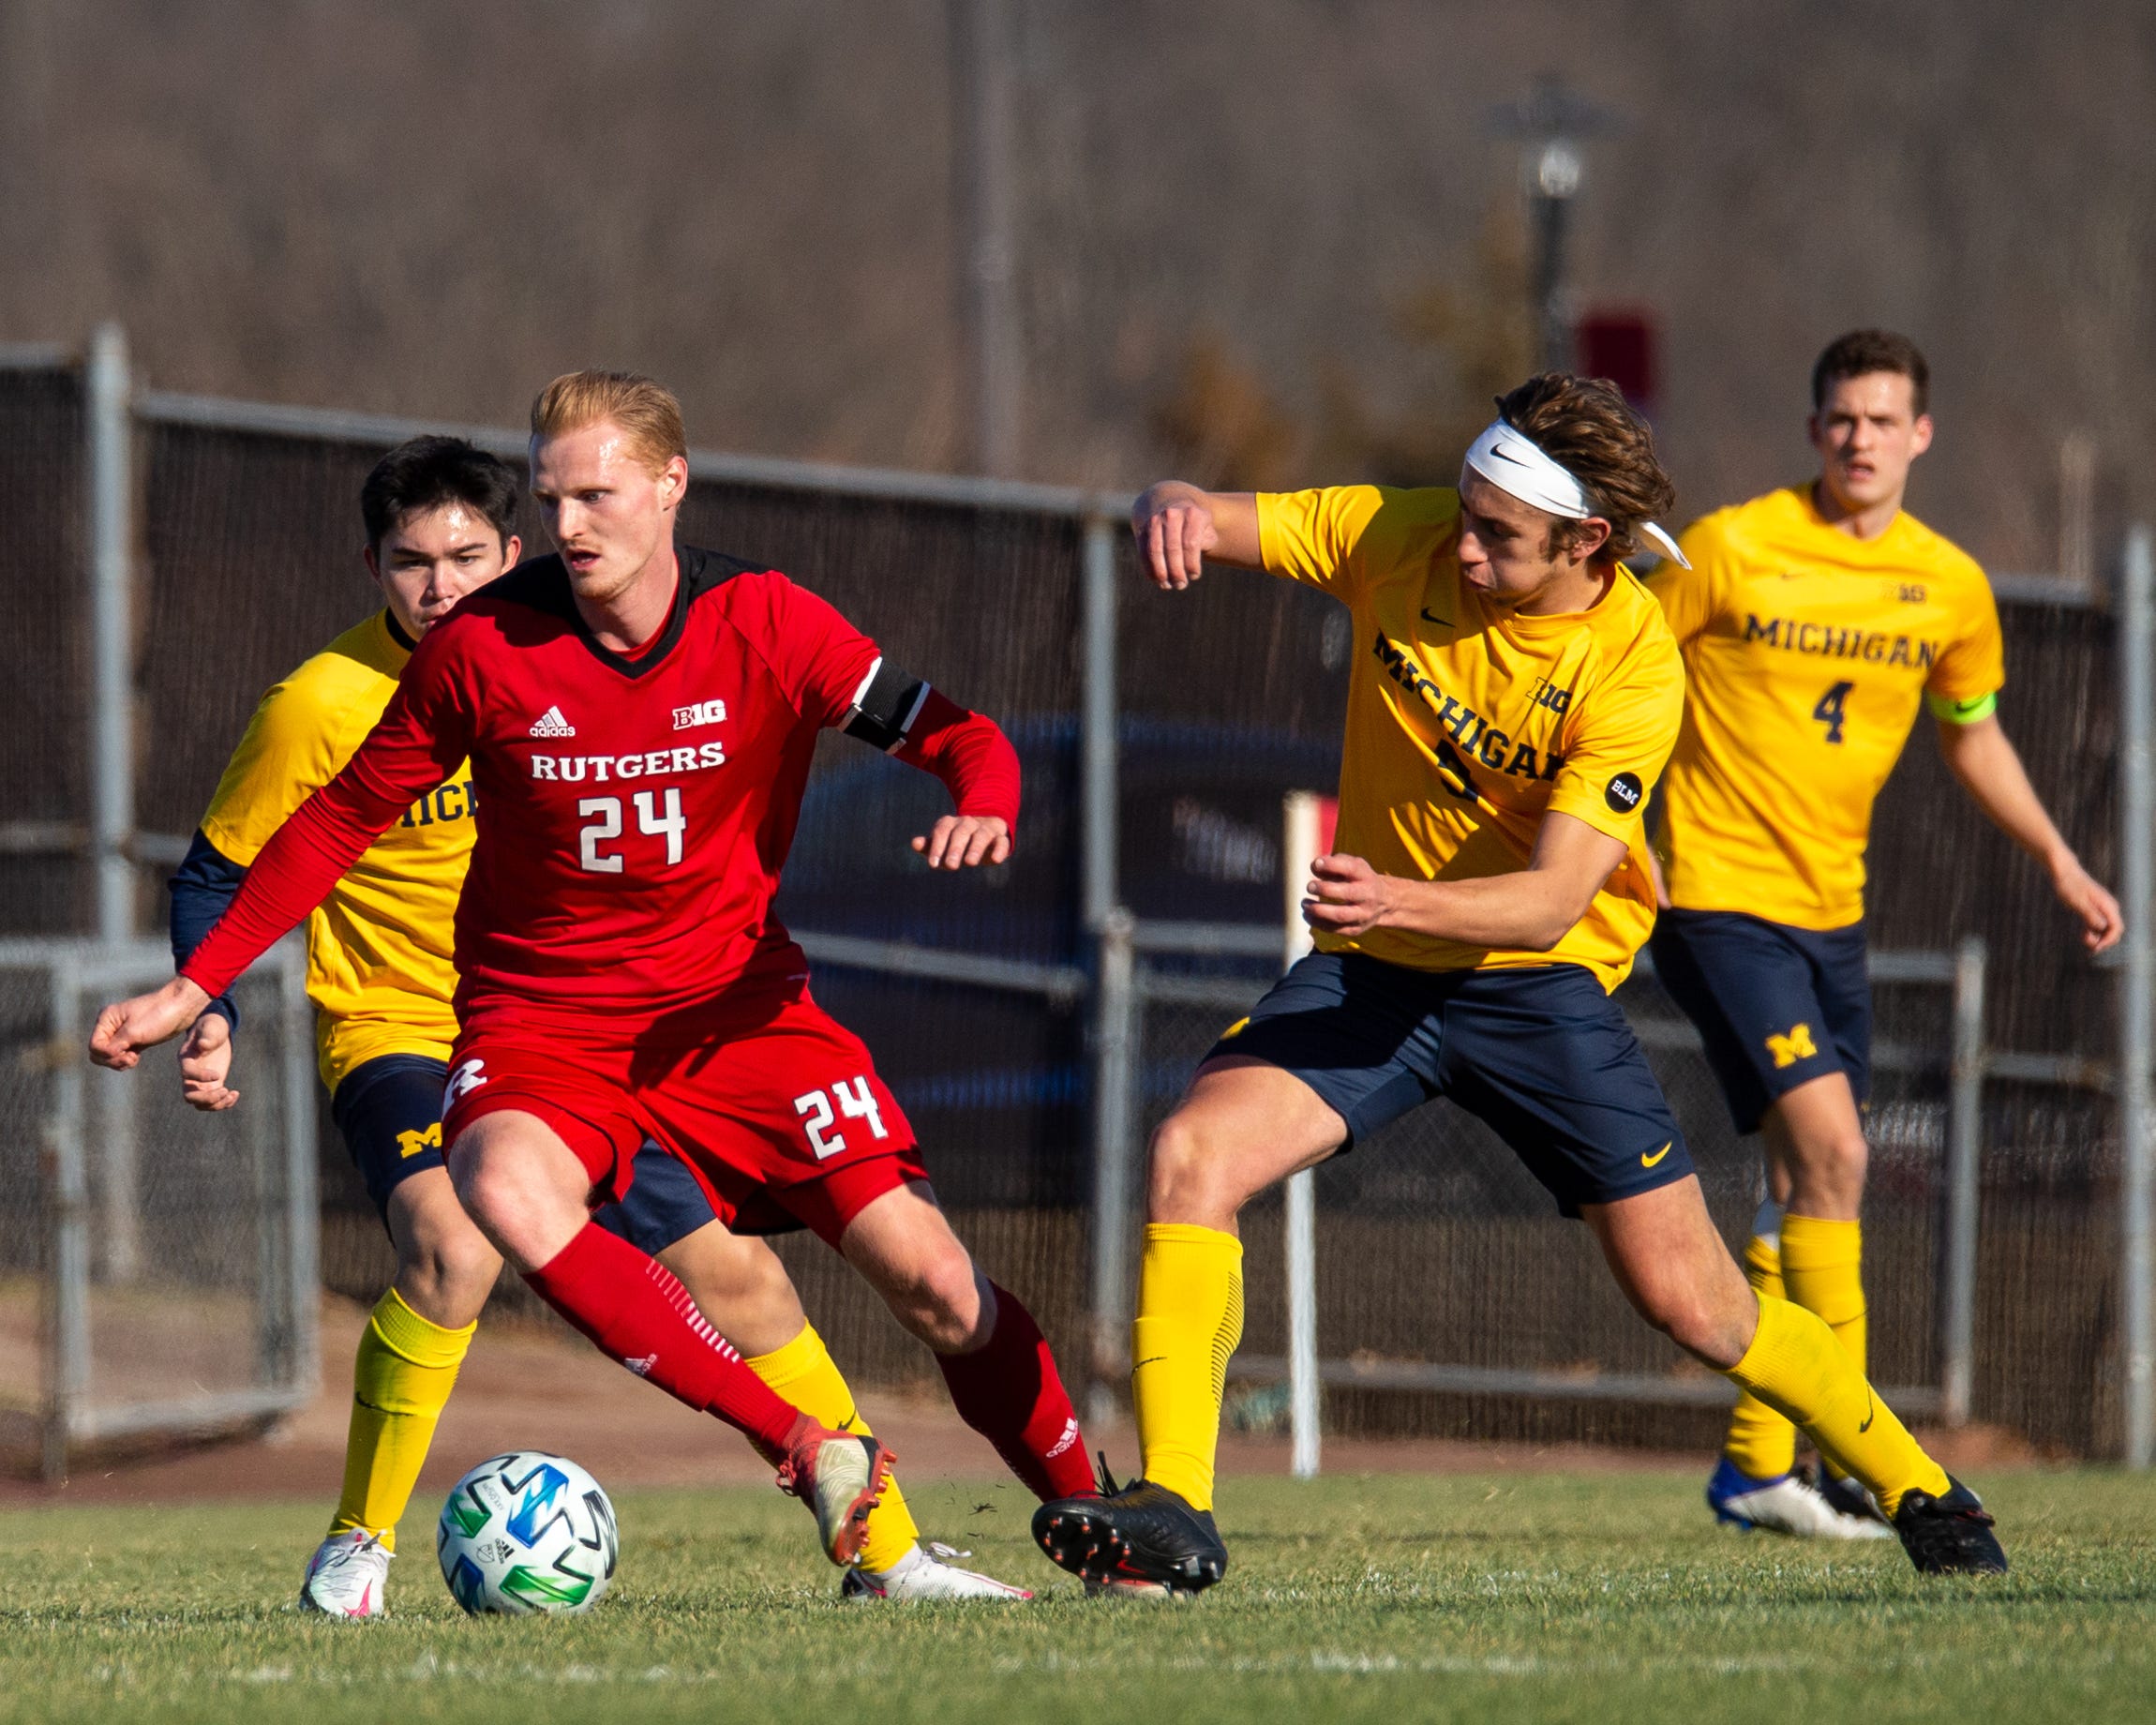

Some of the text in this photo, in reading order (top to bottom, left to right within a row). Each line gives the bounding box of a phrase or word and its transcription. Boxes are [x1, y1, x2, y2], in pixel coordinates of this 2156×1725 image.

[1744, 613, 1939, 669] MICHIGAN
[529, 726, 576, 738] adidas
[1812, 679, 1855, 743] 4
[532, 742, 726, 782] RUTGERS
[1611, 779, 1639, 805] BLM
[578, 788, 687, 873] 24
[1764, 1023, 1818, 1069] M
[396, 1122, 442, 1159] M
[793, 1075, 889, 1161] 24
